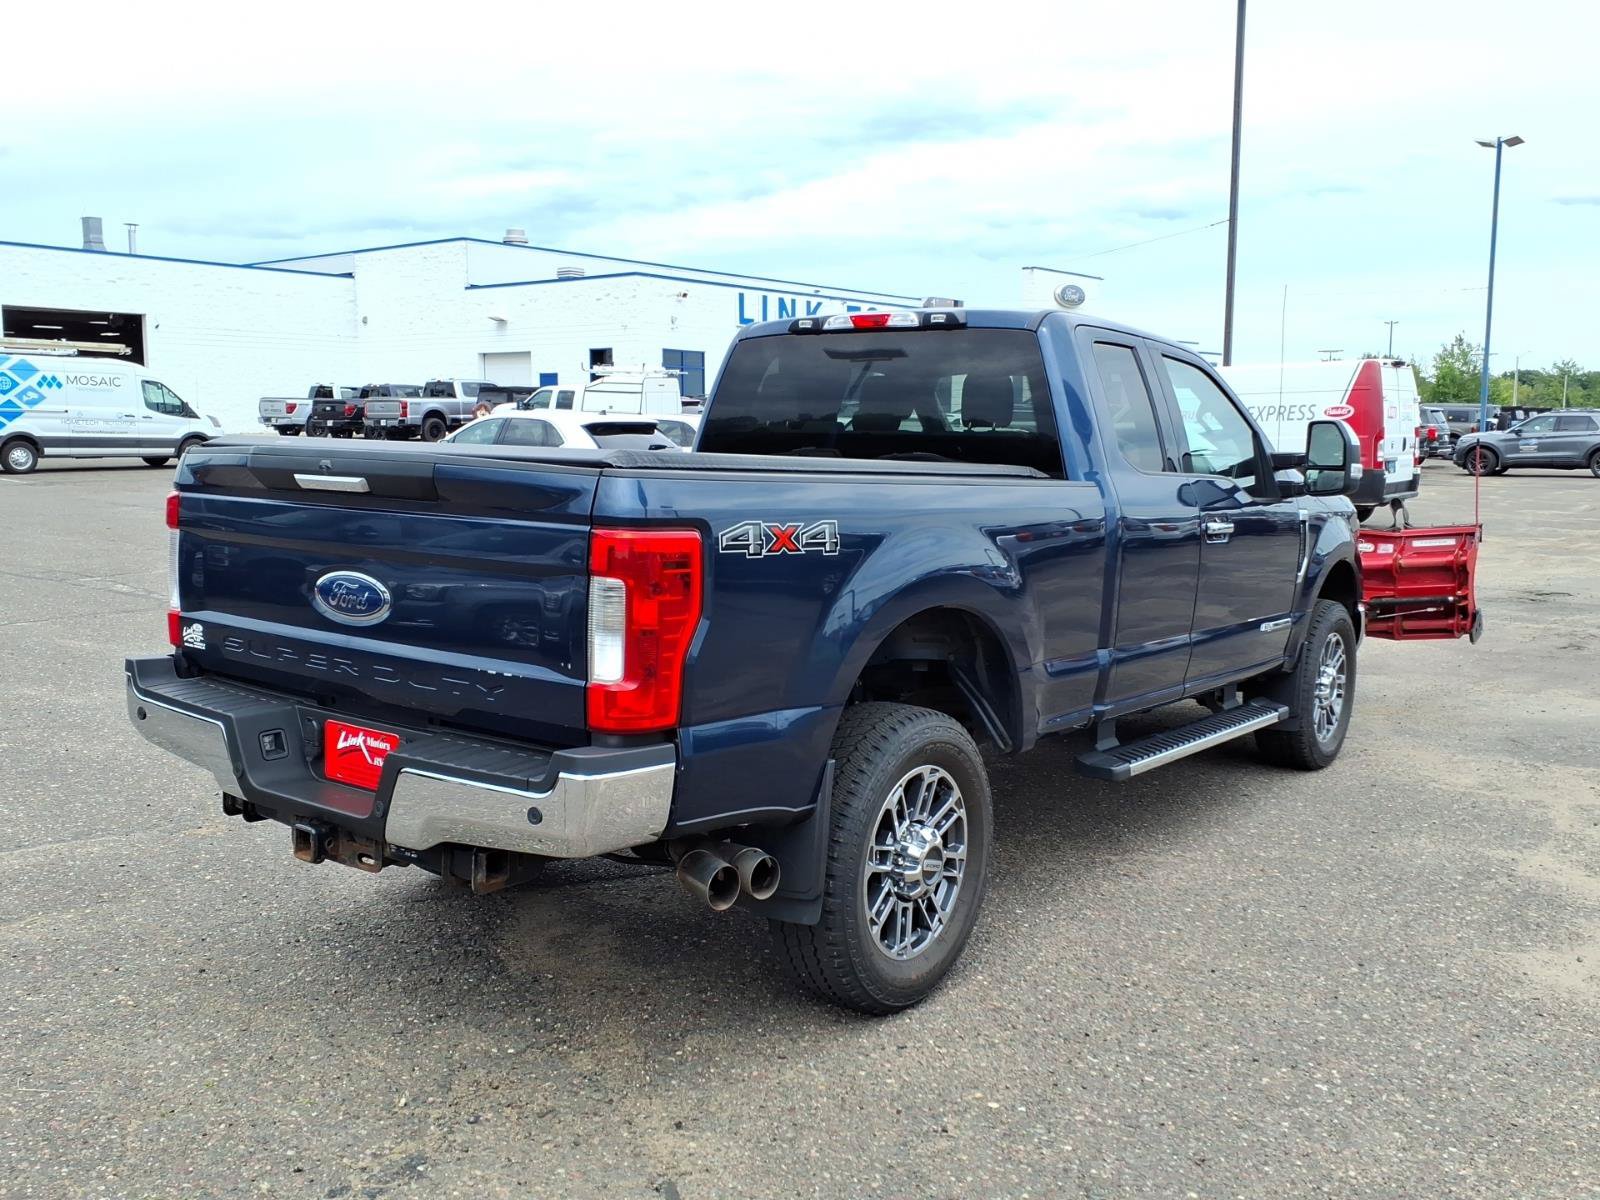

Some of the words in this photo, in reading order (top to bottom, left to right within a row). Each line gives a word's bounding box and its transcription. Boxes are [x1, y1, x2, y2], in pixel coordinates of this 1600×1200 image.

[66, 375, 121, 387] MOSAIC
[328, 580, 369, 610] Ford
[224, 637, 359, 676] SUPER
[373, 665, 505, 701] DUTY
[366, 736, 391, 750] Motors
